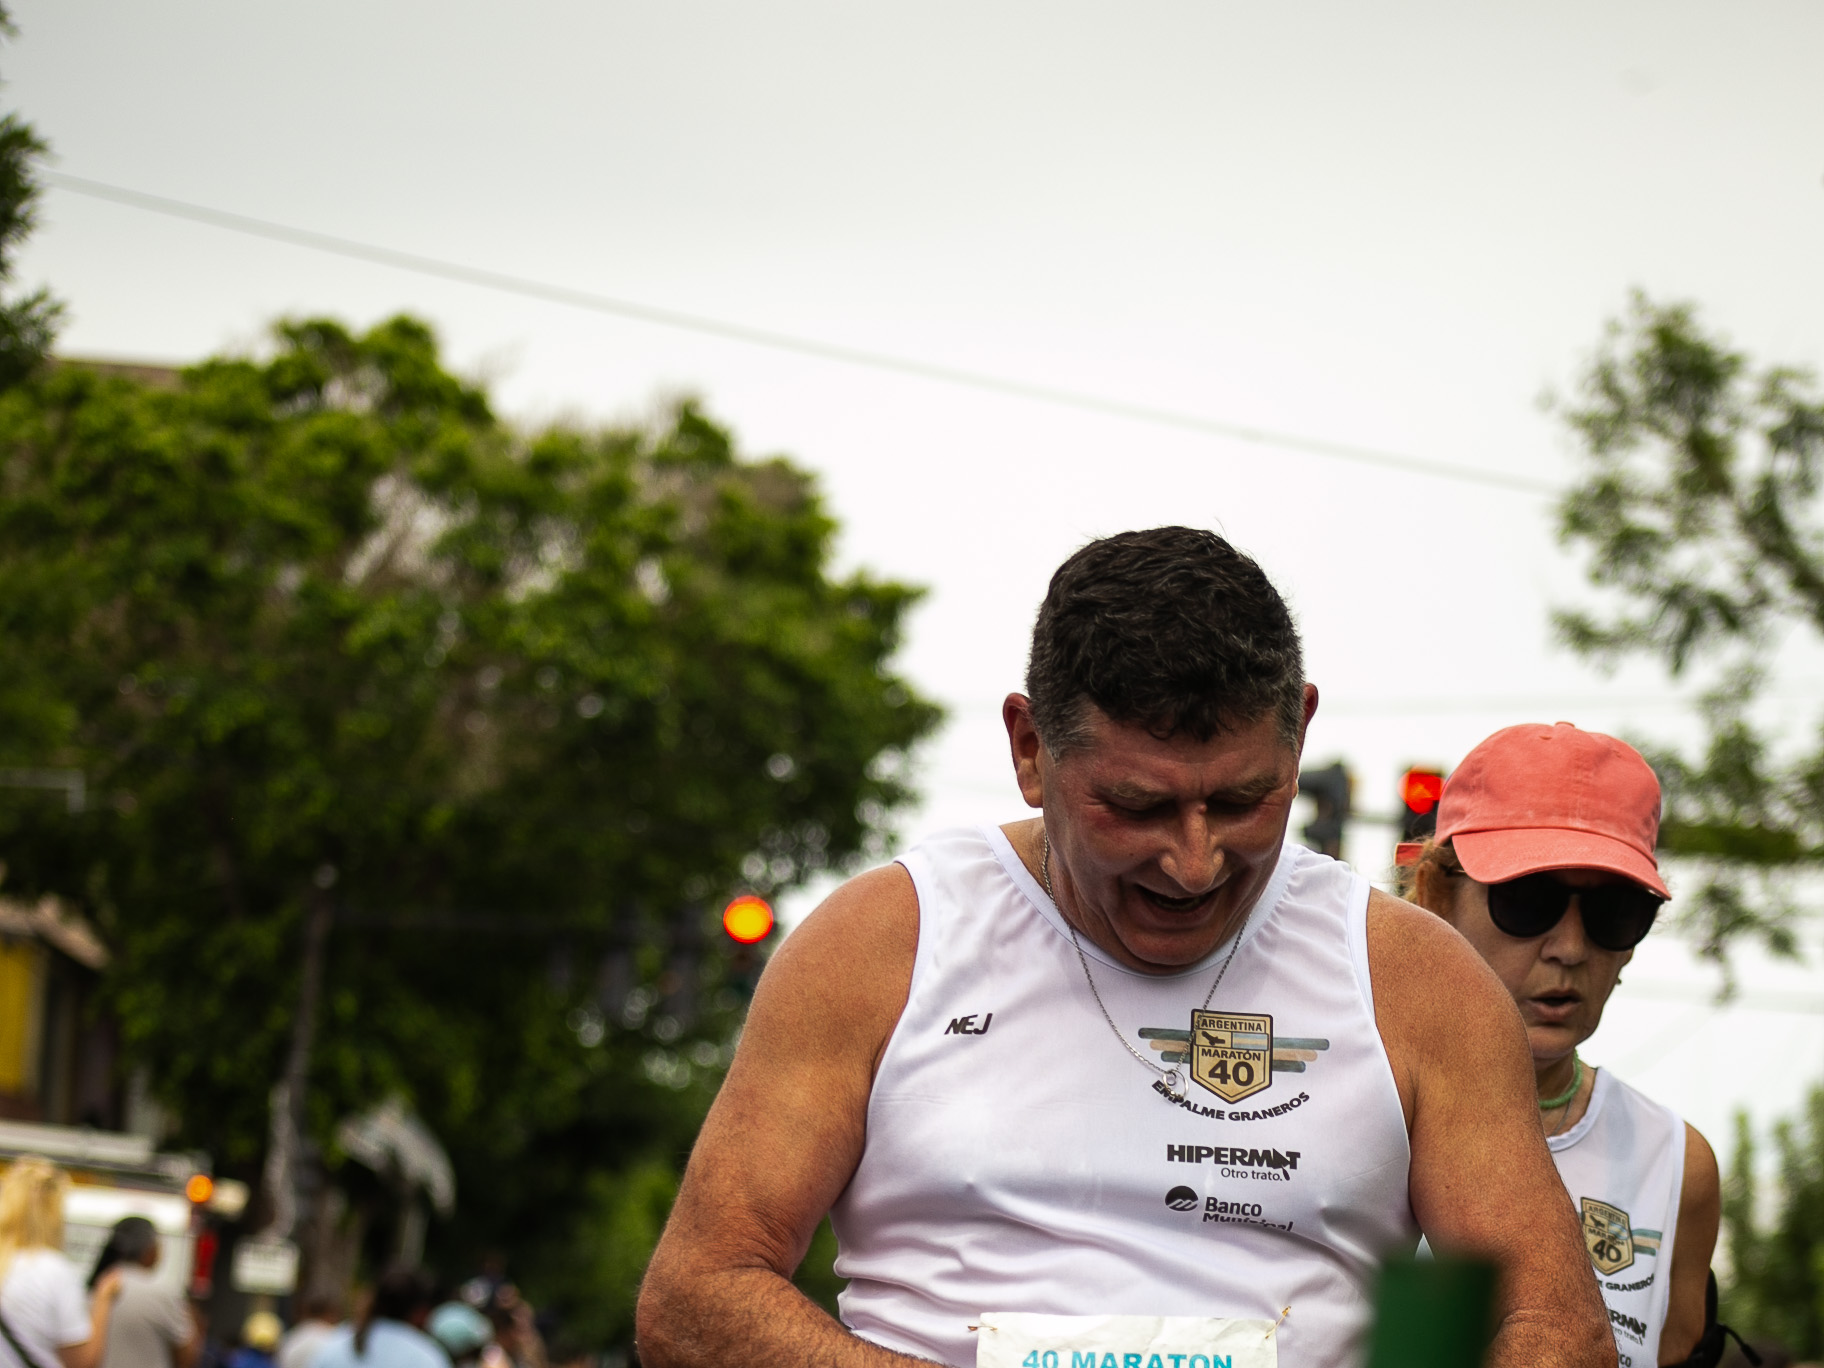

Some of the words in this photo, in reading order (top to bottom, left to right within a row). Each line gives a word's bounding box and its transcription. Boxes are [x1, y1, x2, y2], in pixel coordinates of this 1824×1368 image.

[944, 1012, 993, 1035] NEJ
[1201, 1018, 1262, 1032] ARGENTINA
[1201, 1048, 1261, 1062] MARATÓN
[1208, 1059, 1255, 1087] 40
[1228, 1091, 1311, 1121] GRANEROS
[1220, 1167, 1248, 1179] Otro
[1205, 1196, 1262, 1217] Banco
[1592, 1239, 1622, 1263] 40
